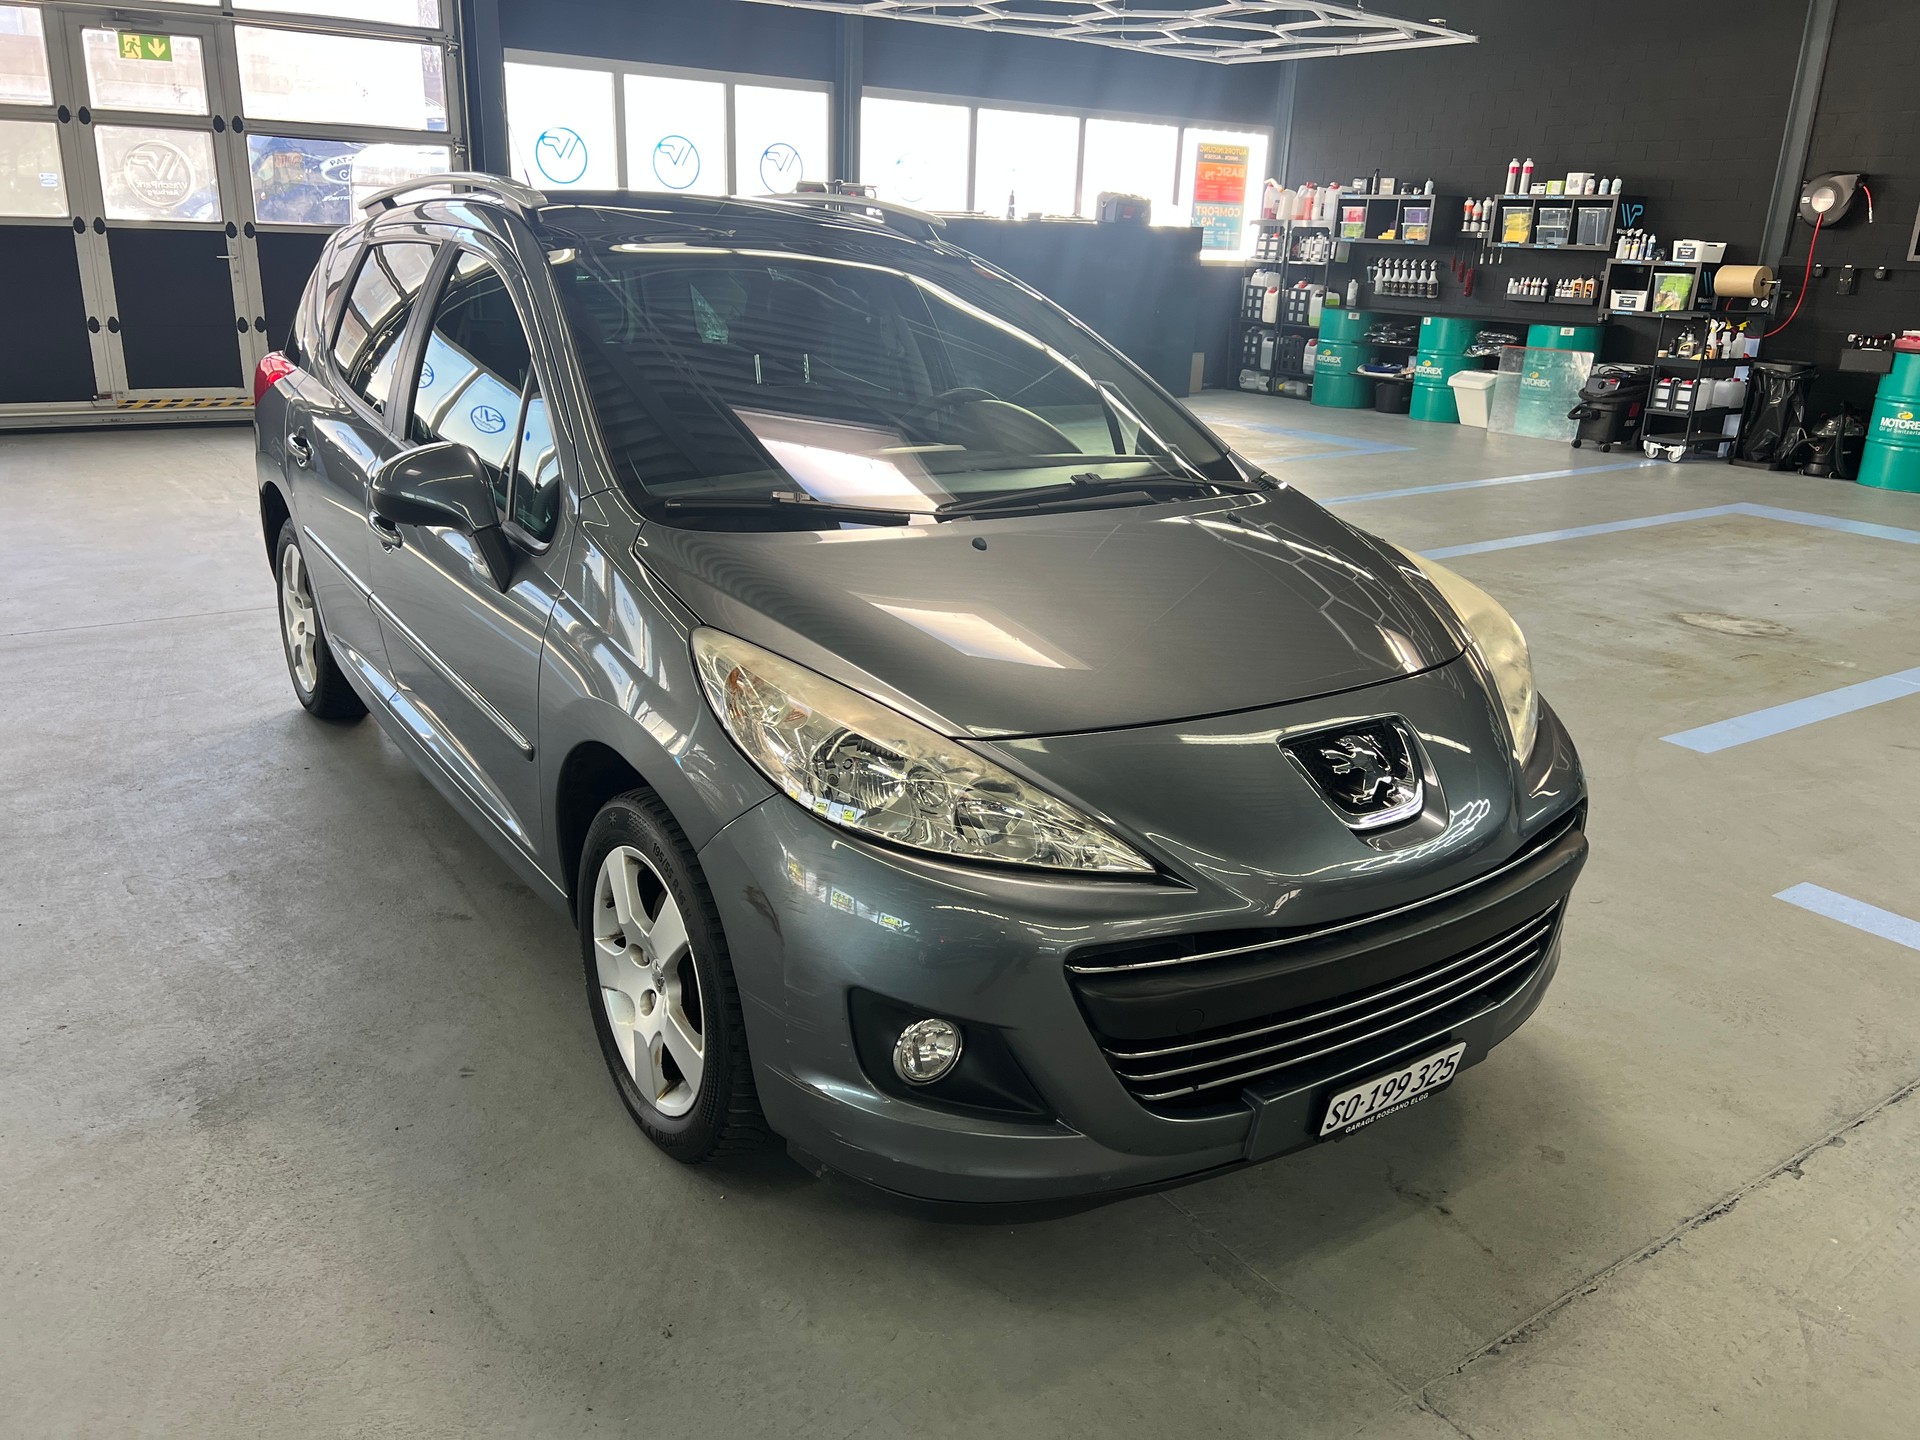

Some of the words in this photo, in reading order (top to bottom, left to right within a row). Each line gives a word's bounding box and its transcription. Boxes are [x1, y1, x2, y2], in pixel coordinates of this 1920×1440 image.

[653, 842, 674, 879] 195/55
[672, 879, 679, 892] R
[1410, 1051, 1460, 1093] 325
[1345, 1114, 1375, 1134] GARAGE
[1376, 1099, 1410, 1120] ROSSANO
[1410, 1092, 1429, 1106] ELGG
